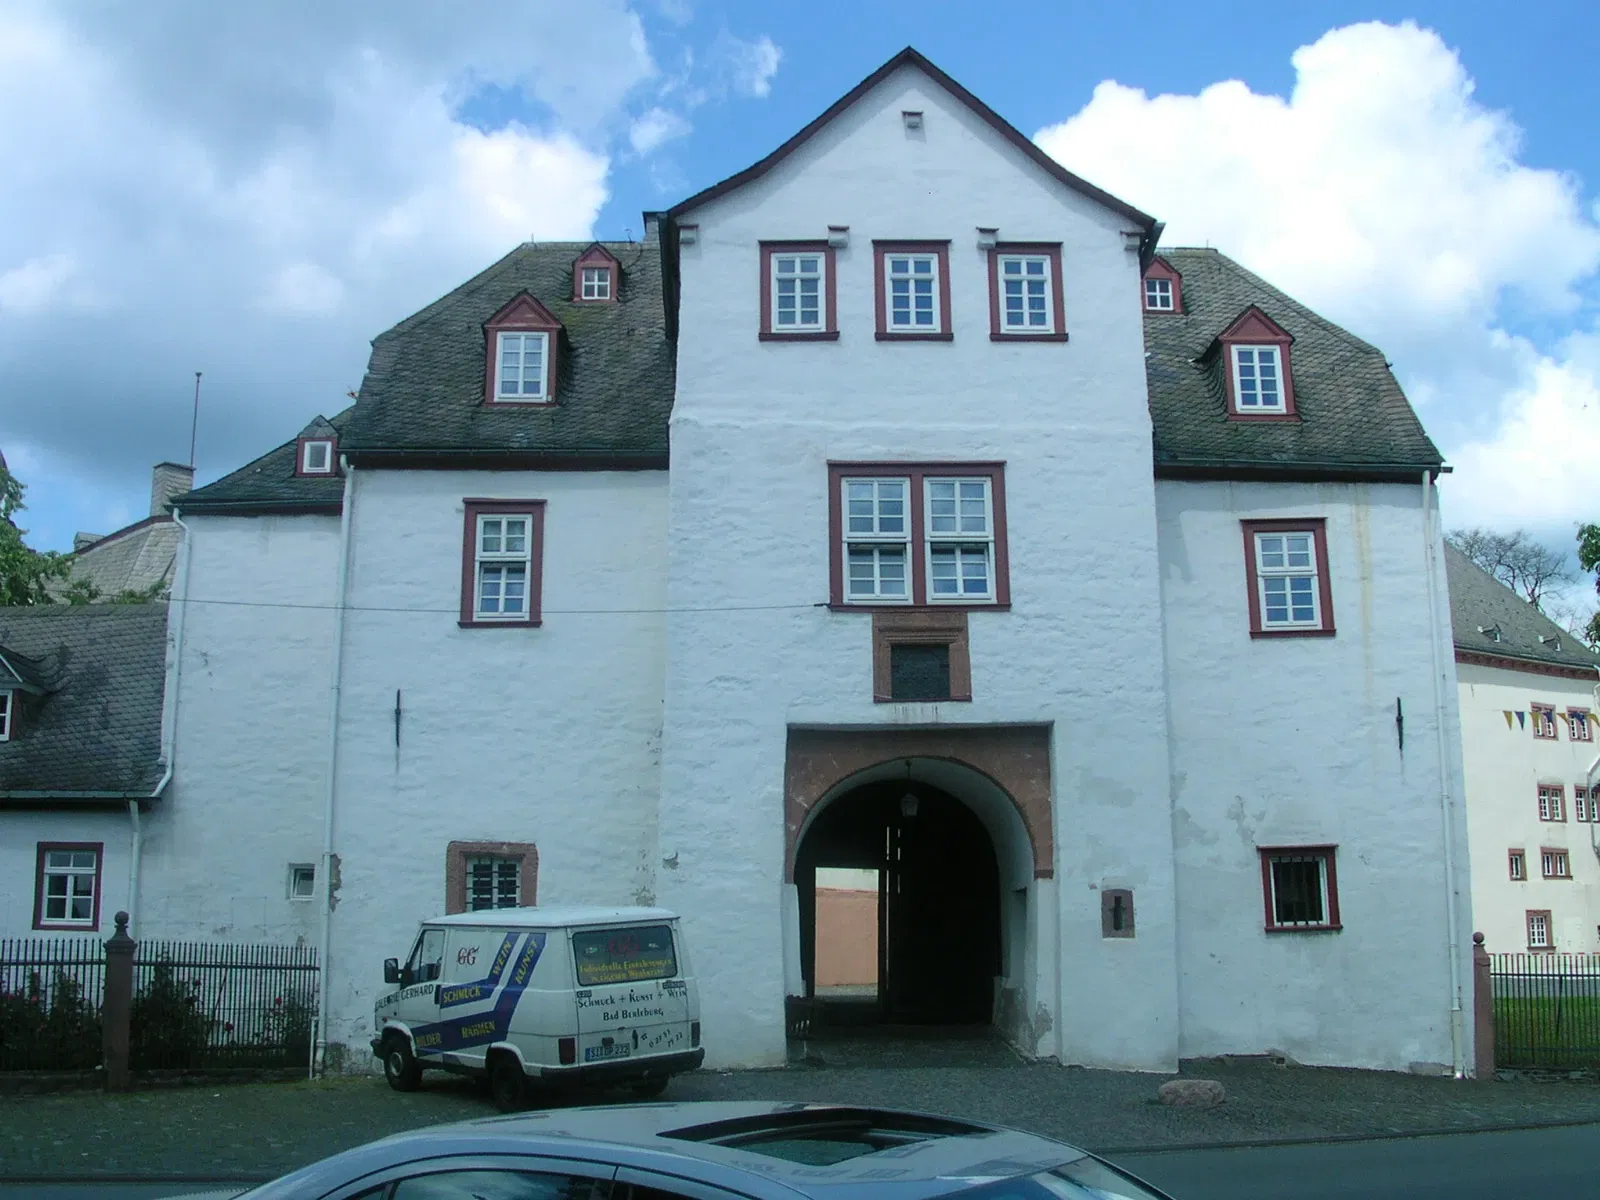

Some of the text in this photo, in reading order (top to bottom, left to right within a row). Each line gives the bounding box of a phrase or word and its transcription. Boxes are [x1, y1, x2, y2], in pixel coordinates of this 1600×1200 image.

[493, 940, 512, 976] WEIN
[515, 939, 538, 984] KUNST
[401, 984, 434, 1000] GERHARD
[443, 985, 481, 1004] SCHMUCK
[461, 1020, 496, 1039] RAHMEN
